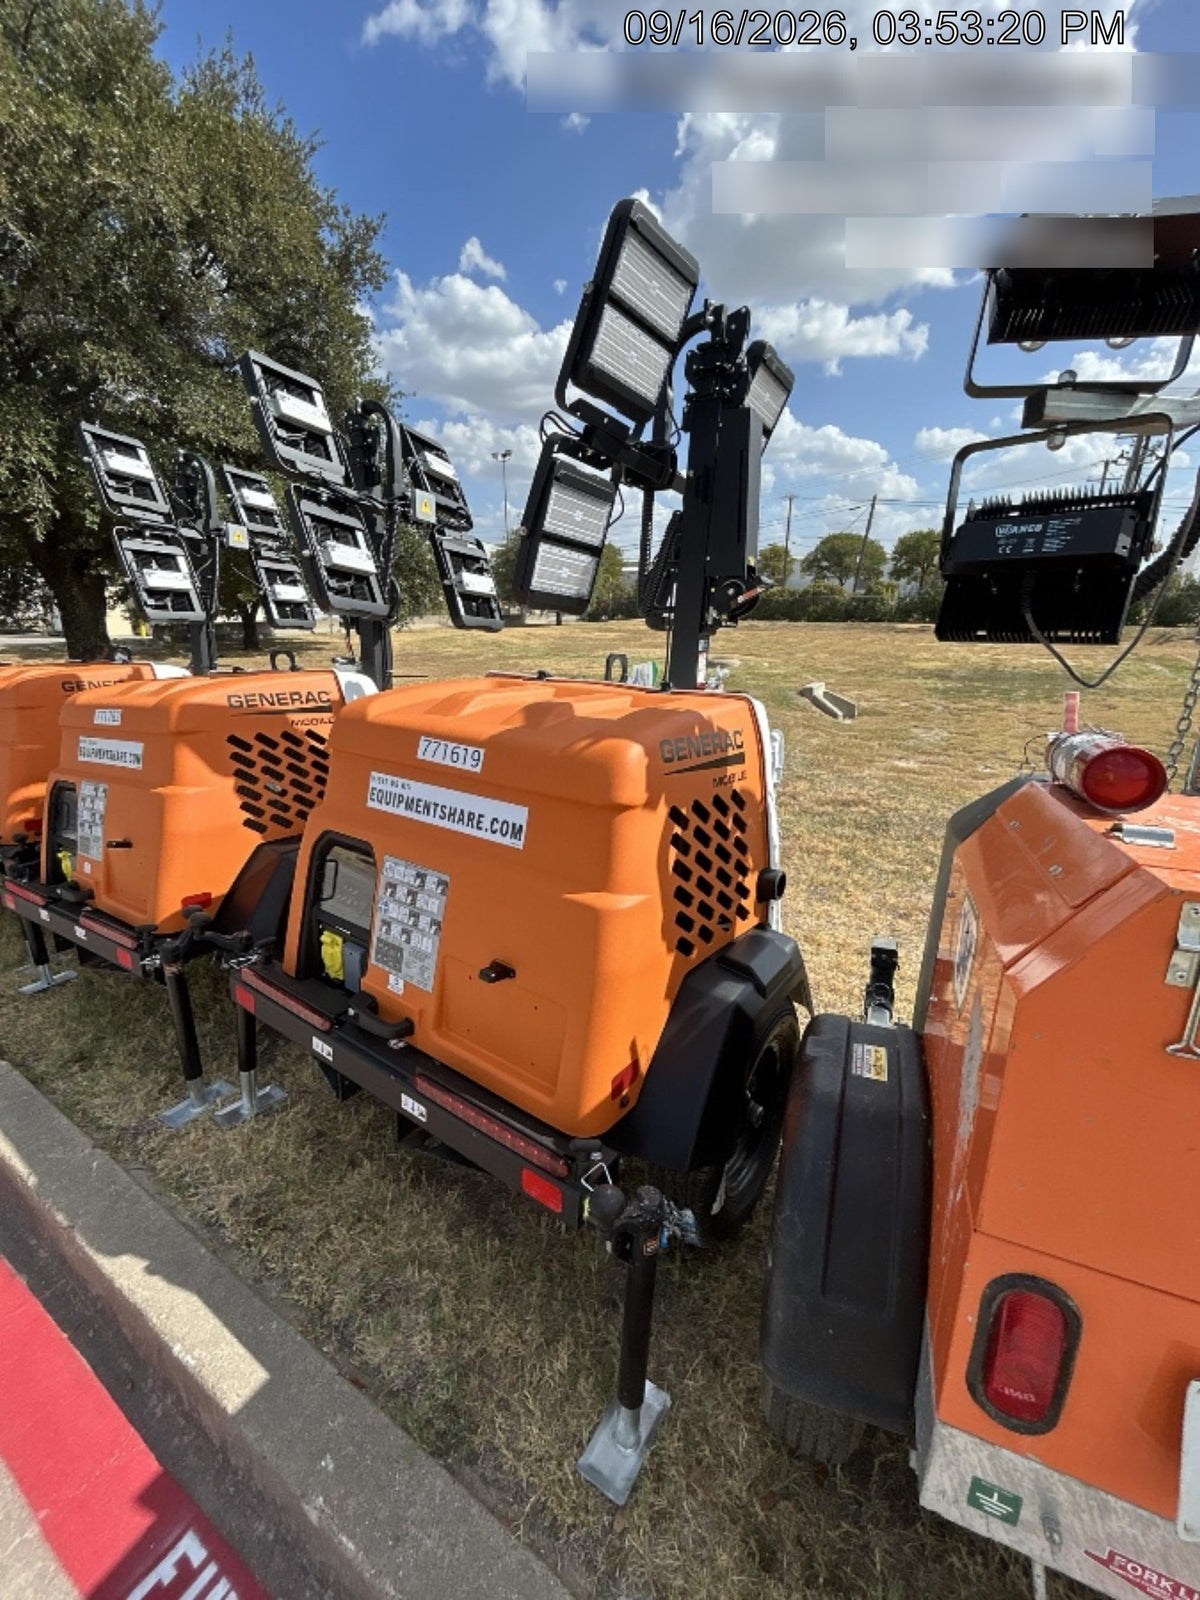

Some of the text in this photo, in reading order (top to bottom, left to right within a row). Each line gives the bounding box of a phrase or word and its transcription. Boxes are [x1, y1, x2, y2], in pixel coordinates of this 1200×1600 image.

[227, 690, 332, 708] GENERAC
[421, 739, 481, 768] 771619
[660, 730, 744, 763] GENERAC
[369, 787, 524, 842] EQUIPMENTSHARE.COM
